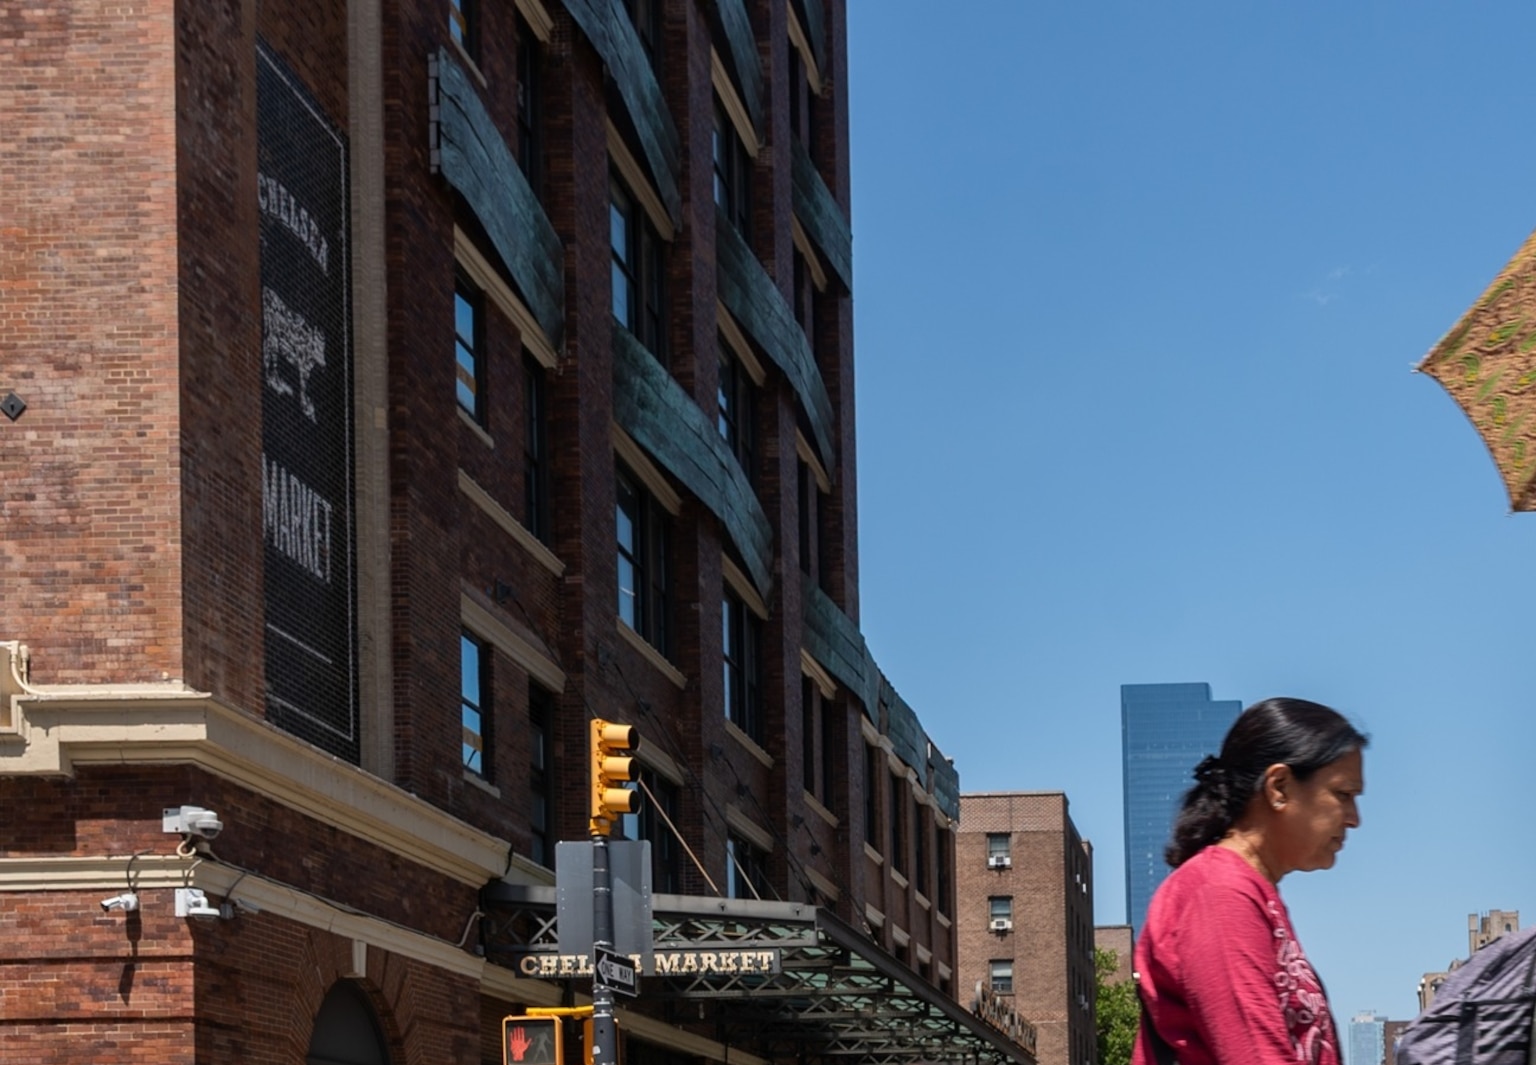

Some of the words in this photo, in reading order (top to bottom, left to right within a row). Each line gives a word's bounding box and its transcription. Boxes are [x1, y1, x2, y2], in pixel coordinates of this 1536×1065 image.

[257, 171, 329, 277] CHELSEA
[262, 452, 332, 584] MARKET
[520, 954, 642, 975] CHELA
[654, 952, 774, 973] MARKET
[600, 960, 614, 978] ONE
[618, 966, 632, 980] WAY
